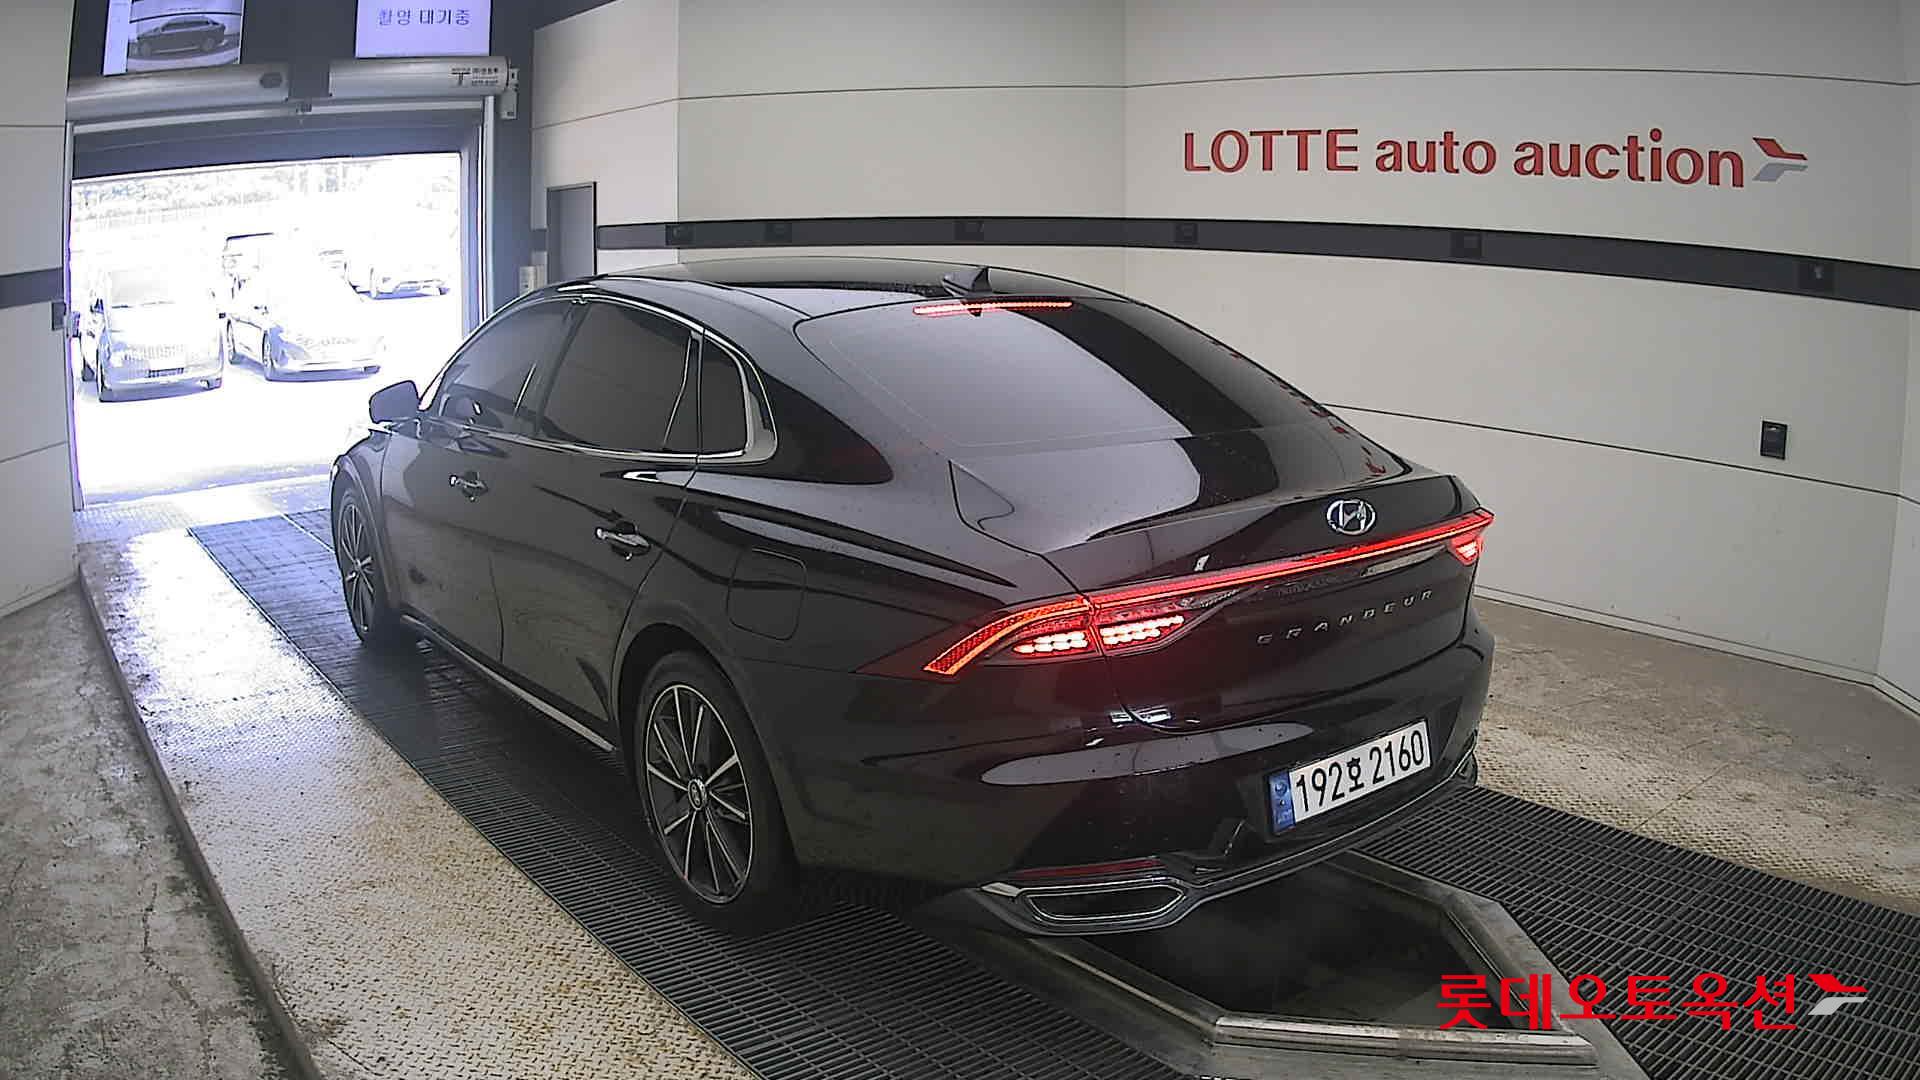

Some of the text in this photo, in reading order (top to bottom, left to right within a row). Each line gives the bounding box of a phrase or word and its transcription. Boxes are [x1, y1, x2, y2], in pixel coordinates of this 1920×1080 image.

[419, 9, 471, 26] 대기중
[1183, 129, 1745, 189] LOTTE auto auction
[1256, 588, 1433, 645] GRANDEUR
[1296, 730, 1425, 812] 192호 2160
